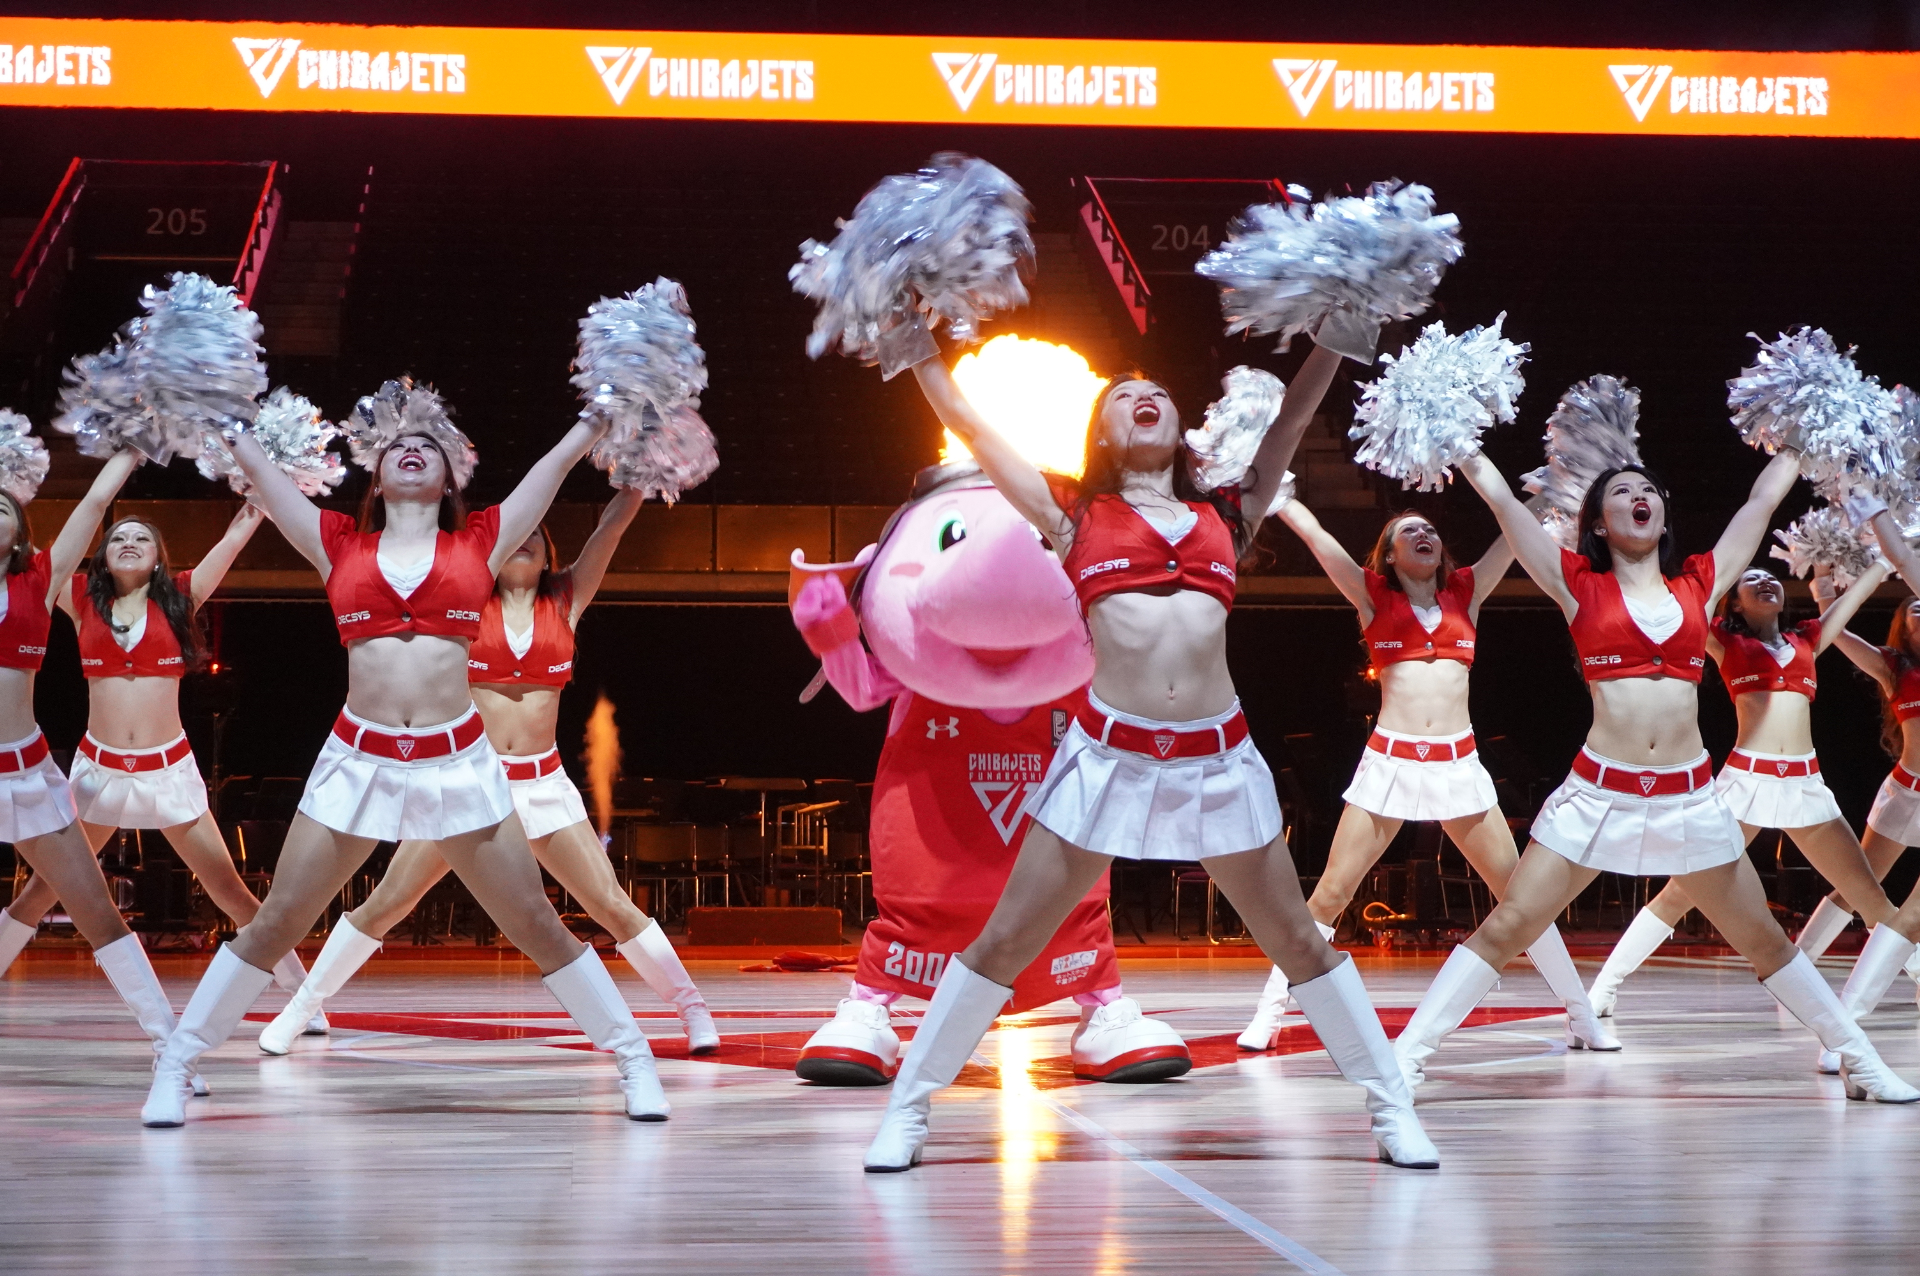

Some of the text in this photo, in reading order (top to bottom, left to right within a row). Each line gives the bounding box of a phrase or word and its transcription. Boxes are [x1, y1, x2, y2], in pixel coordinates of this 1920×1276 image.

[298, 50, 465, 92] CHIBAJETS
[649, 57, 814, 99] CHIBAJETS
[995, 64, 1157, 105] CHIBAJETS
[1334, 70, 1495, 111] CHIBAJETS
[1670, 76, 1829, 115] CHIBAJETS
[146, 207, 206, 235] 205
[1151, 224, 1211, 251] 204
[1080, 557, 1130, 580] DECSYS
[337, 610, 371, 625] DECSYS
[446, 609, 480, 622] DECSYS
[1374, 641, 1403, 649] DECSYS
[1584, 655, 1622, 666] DECSYS
[968, 753, 1042, 772] CHIBAJETS
